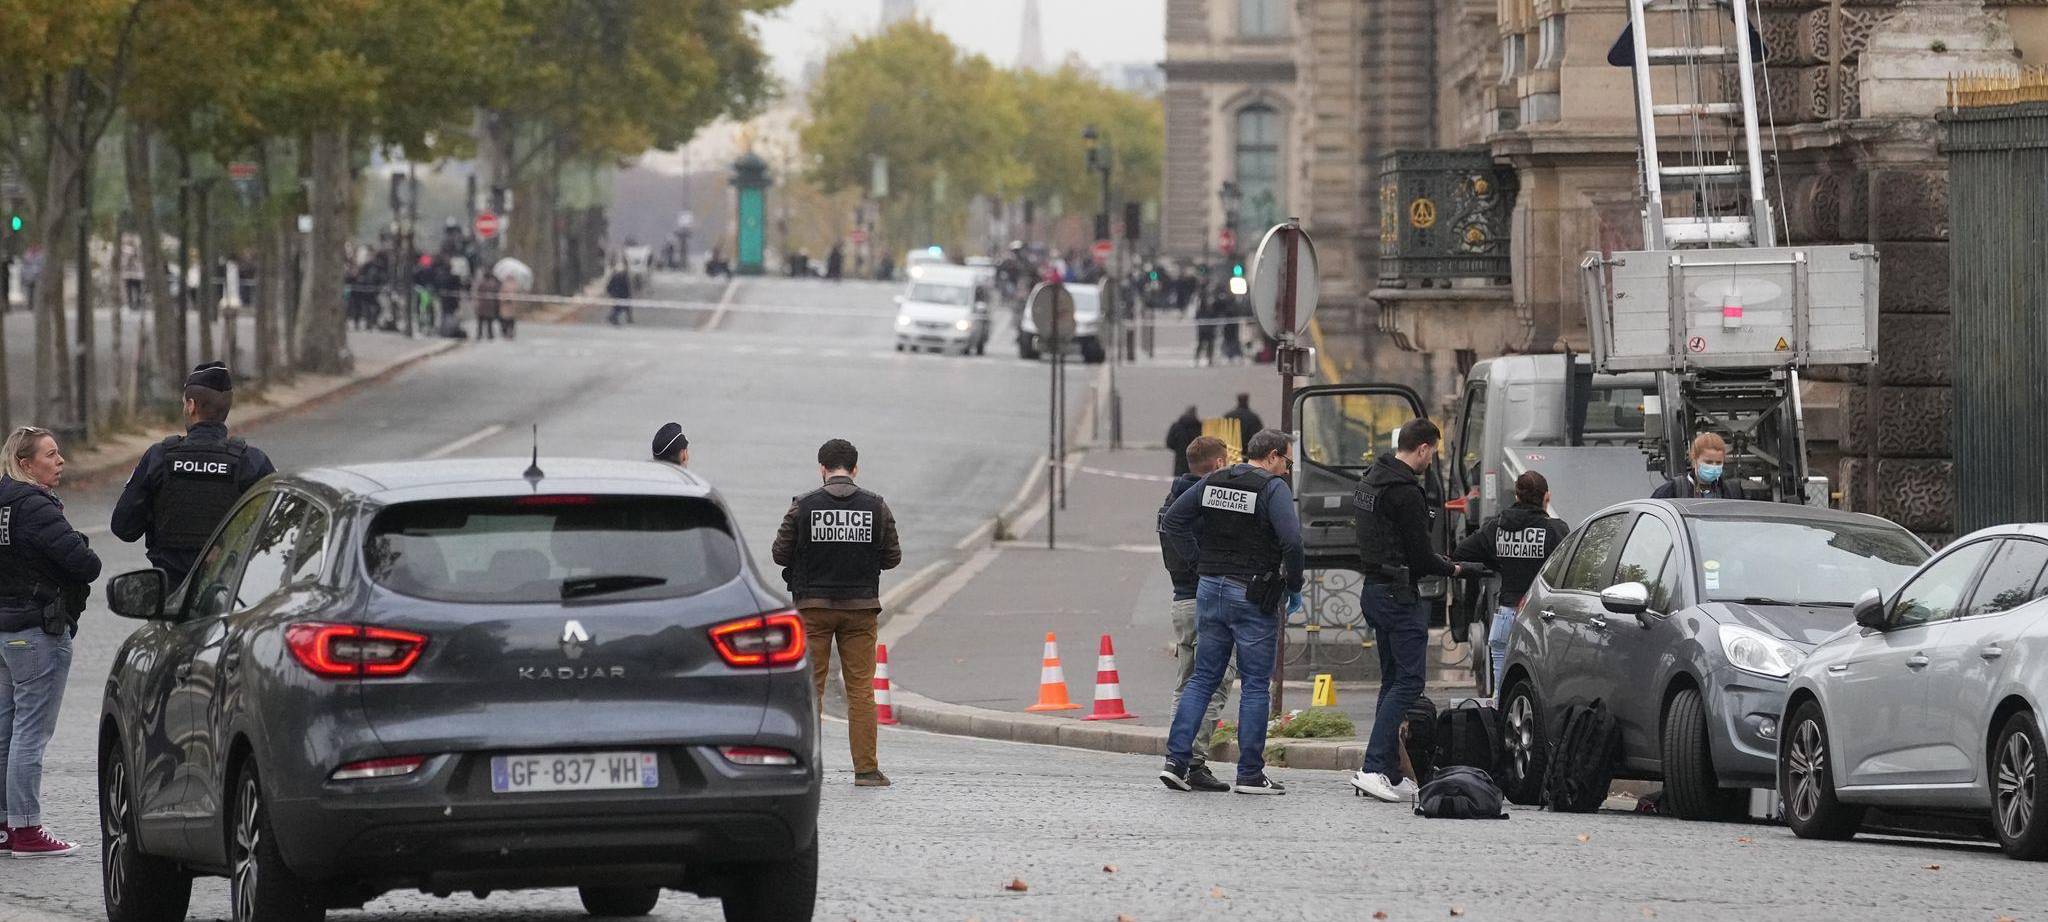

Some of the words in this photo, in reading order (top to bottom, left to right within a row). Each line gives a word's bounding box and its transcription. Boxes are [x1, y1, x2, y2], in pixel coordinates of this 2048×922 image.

[173, 460, 228, 474] POLICE
[1210, 488, 1248, 503] POLICE
[1354, 490, 1374, 504] POLICE
[1207, 499, 1248, 511] JUDICIAIRE
[812, 511, 871, 527] POLICE
[813, 528, 871, 541] JUDICIAIRE
[1497, 528, 1545, 543] POLICE
[518, 666, 625, 680] KADJAR
[1319, 679, 1326, 699] 7
[511, 758, 637, 786] GF-837-WH
